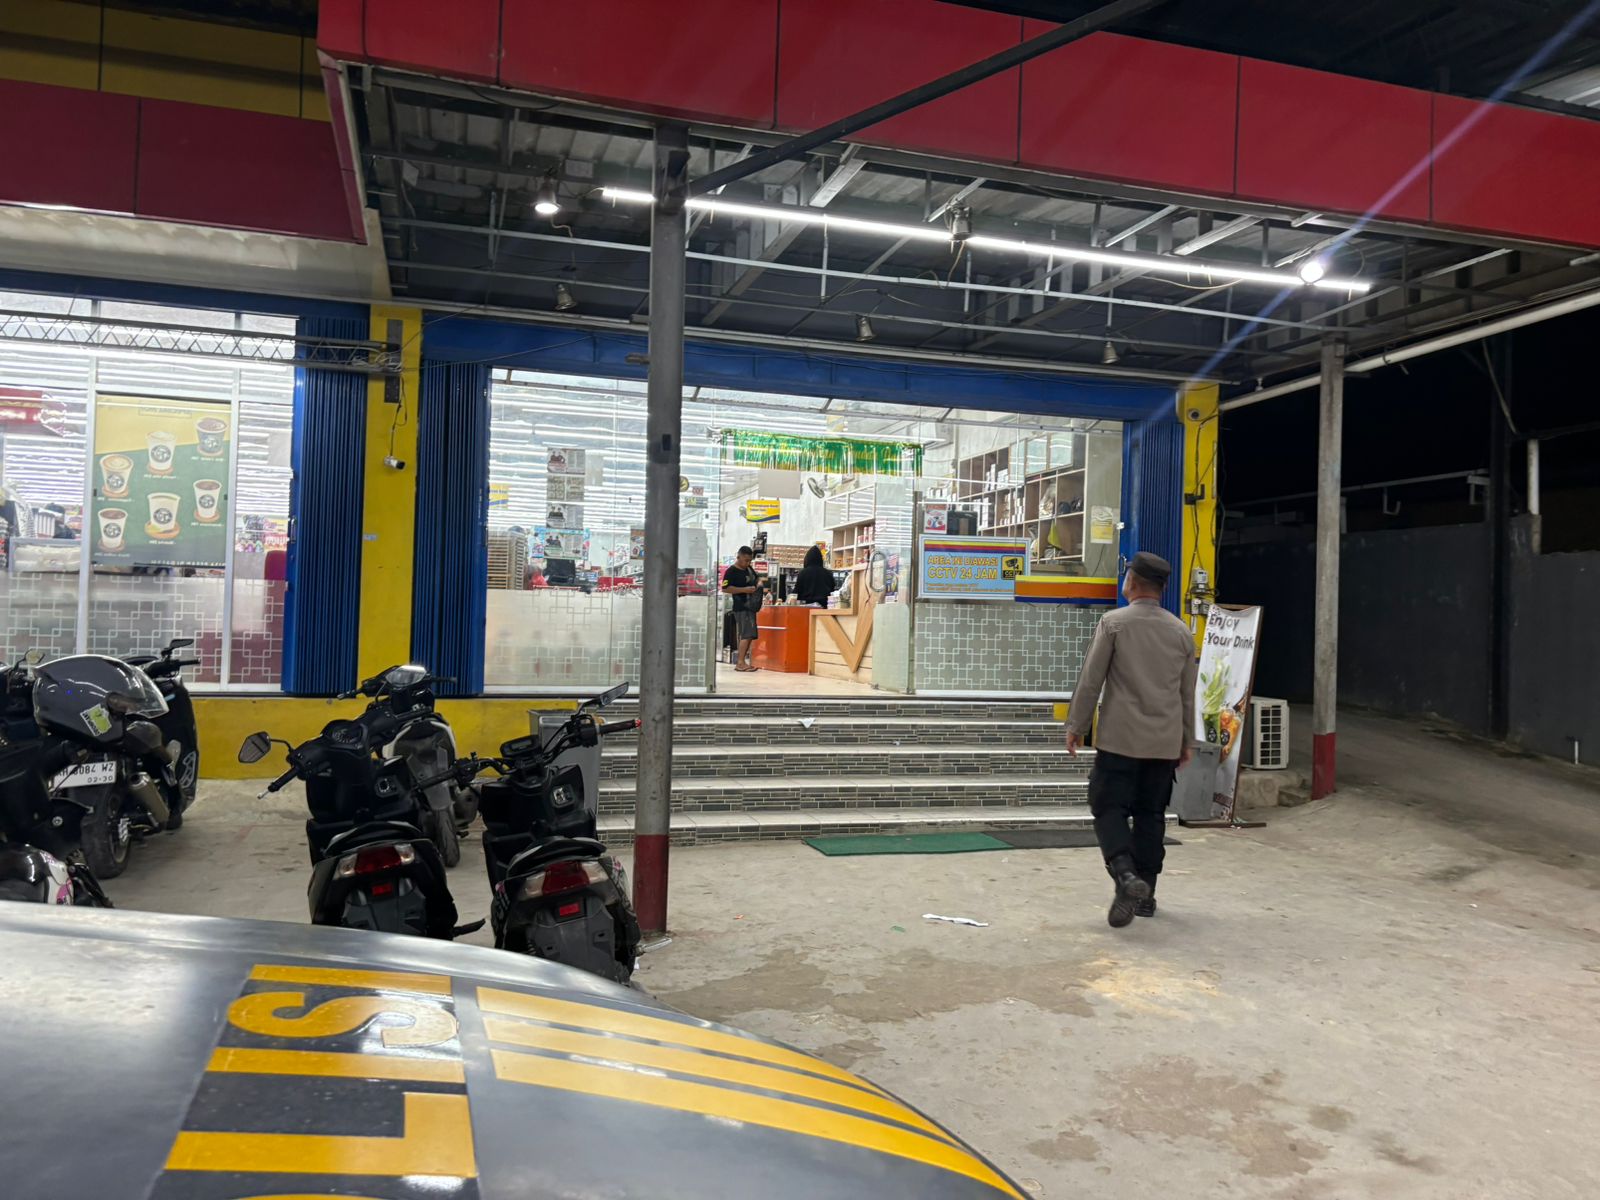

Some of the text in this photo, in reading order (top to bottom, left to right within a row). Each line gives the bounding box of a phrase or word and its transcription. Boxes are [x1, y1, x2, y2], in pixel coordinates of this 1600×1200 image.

[928, 555, 950, 565] AREA
[965, 557, 998, 566] DIAWASI
[928, 566, 997, 580] CCTV 24 JAM
[1209, 614, 1240, 631] Enjoy
[1207, 632, 1255, 649] Your Drink
